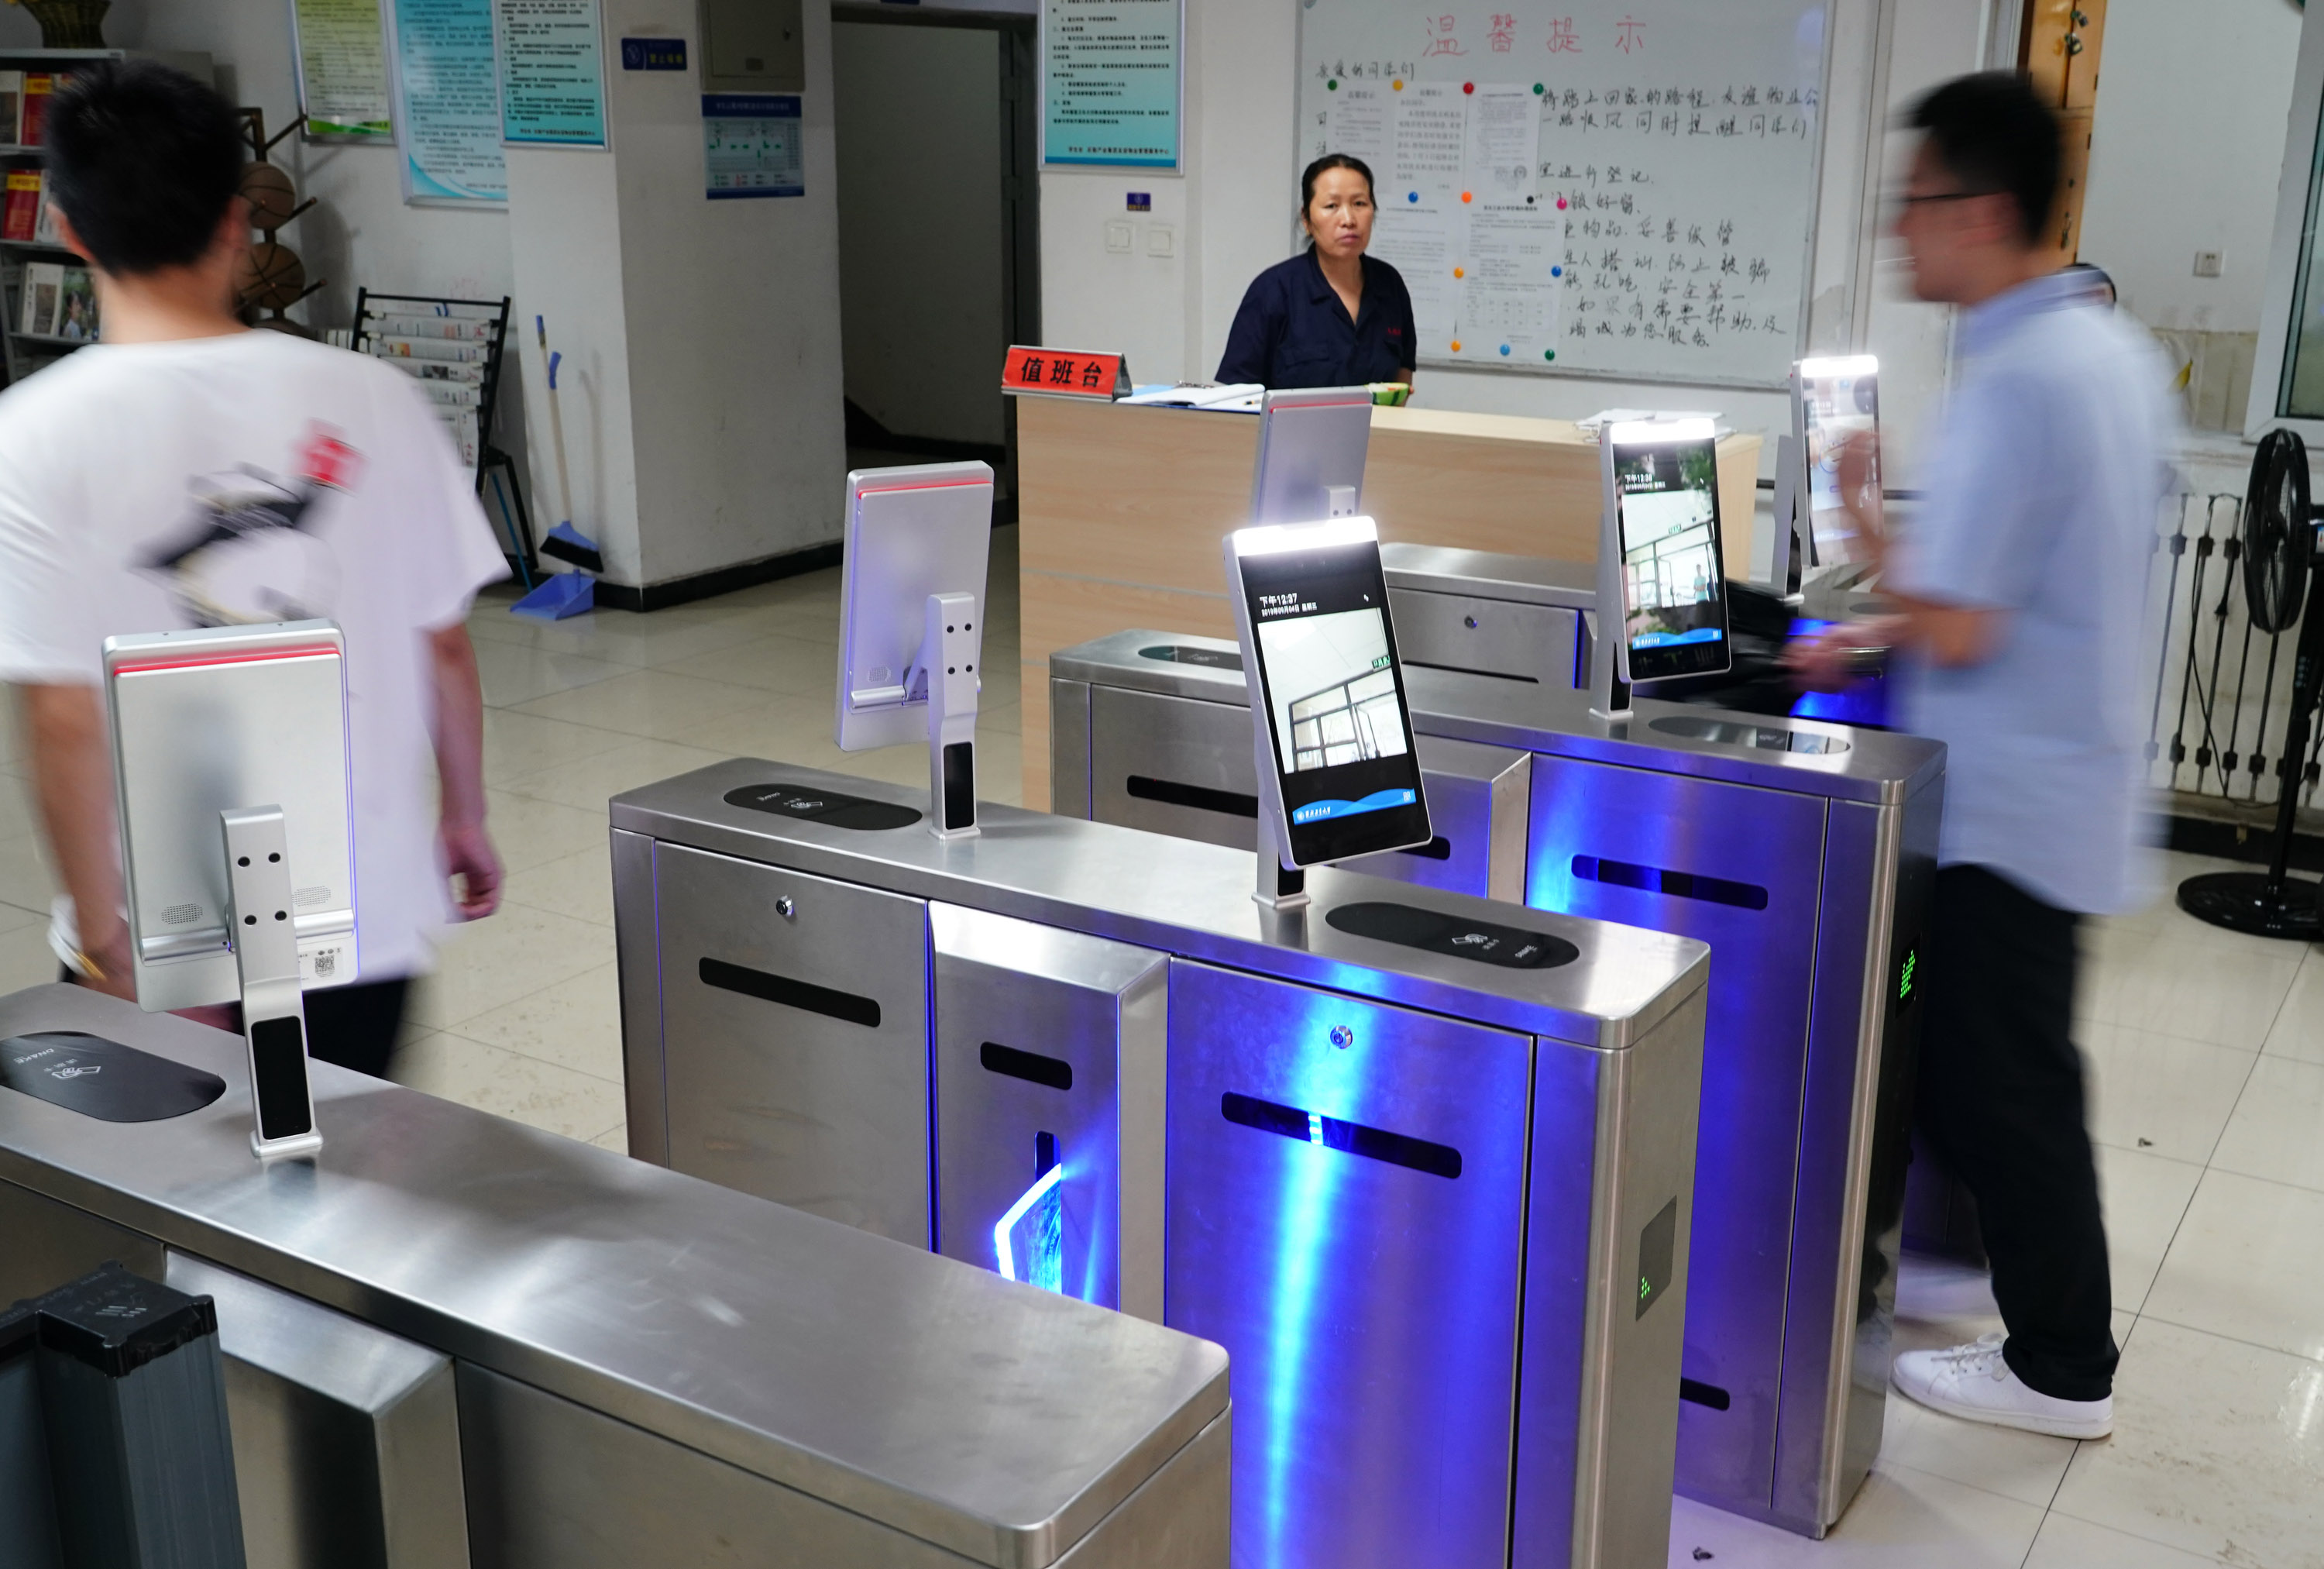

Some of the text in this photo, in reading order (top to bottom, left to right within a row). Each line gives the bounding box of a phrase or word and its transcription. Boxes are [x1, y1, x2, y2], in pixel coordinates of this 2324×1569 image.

[1422, 15, 1648, 58] 温馨提示
[1021, 356, 1103, 388] 值班台
[1259, 592, 1298, 608] 下午12:37
[13, 1048, 54, 1065] DNAKE
